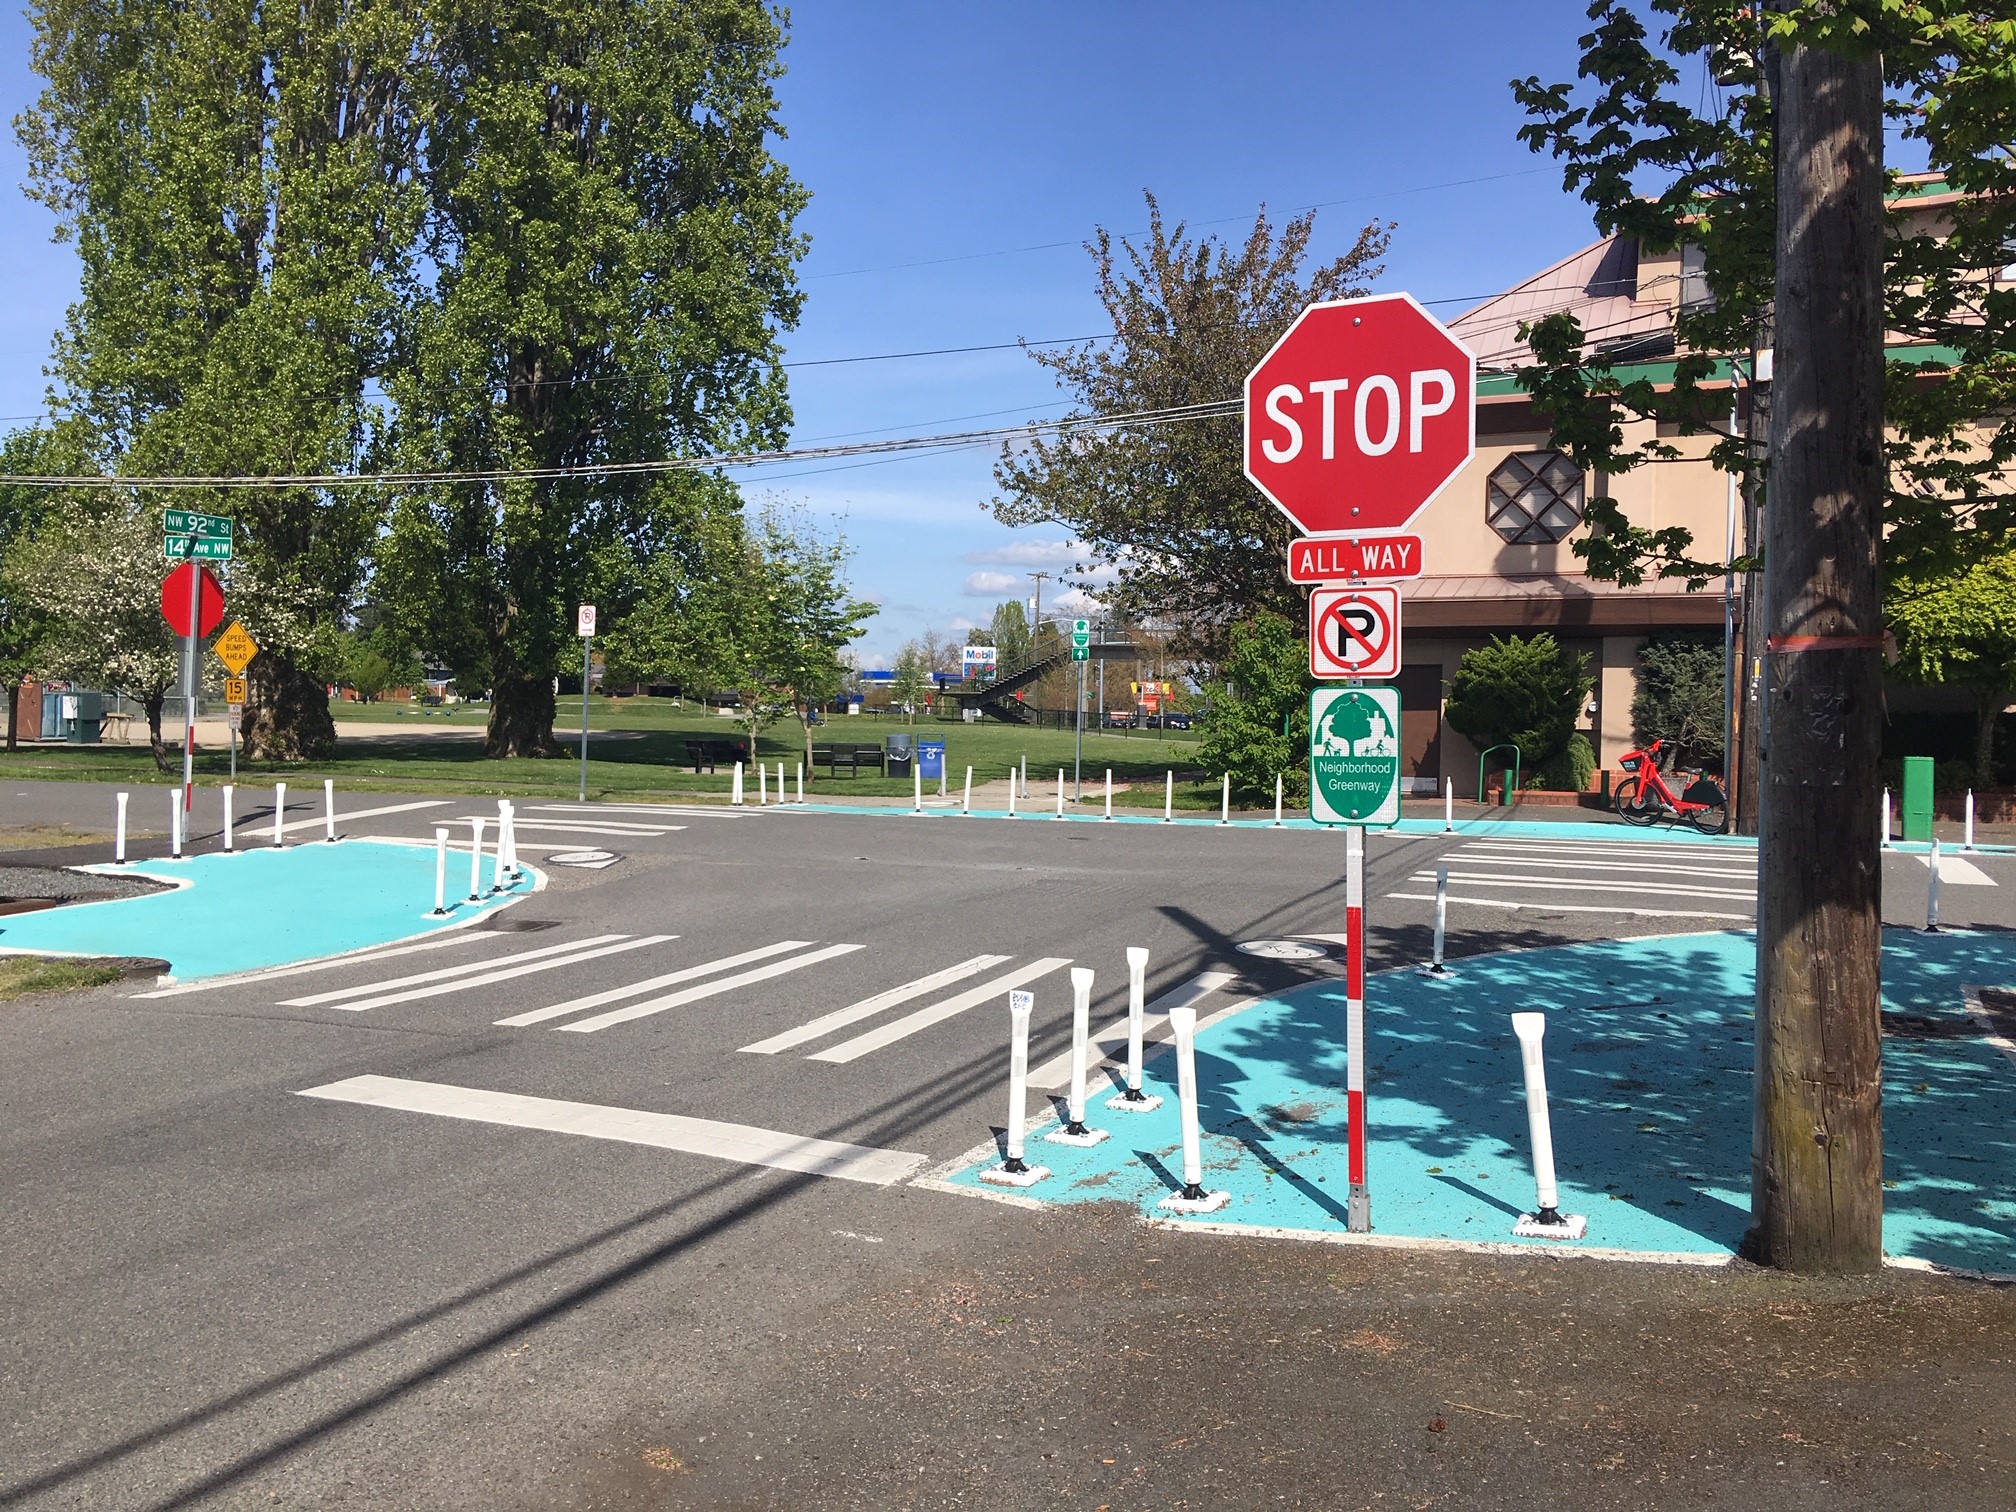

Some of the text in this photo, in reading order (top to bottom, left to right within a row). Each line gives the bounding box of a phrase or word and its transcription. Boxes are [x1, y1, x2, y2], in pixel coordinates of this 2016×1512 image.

[1261, 367, 1456, 464] STOP
[167, 514, 230, 535] NW 92nd St
[193, 542, 209, 554] Ave
[213, 542, 230, 555] NW
[1299, 543, 1412, 574] ALL WAY
[226, 634, 247, 643] SPEED
[225, 643, 247, 652] BUMPS
[225, 653, 248, 661] AHEAD
[966, 649, 994, 660] Mobil
[228, 681, 242, 694] 15
[1319, 761, 1391, 776] Neighborhood
[1328, 778, 1381, 794] Greenway
